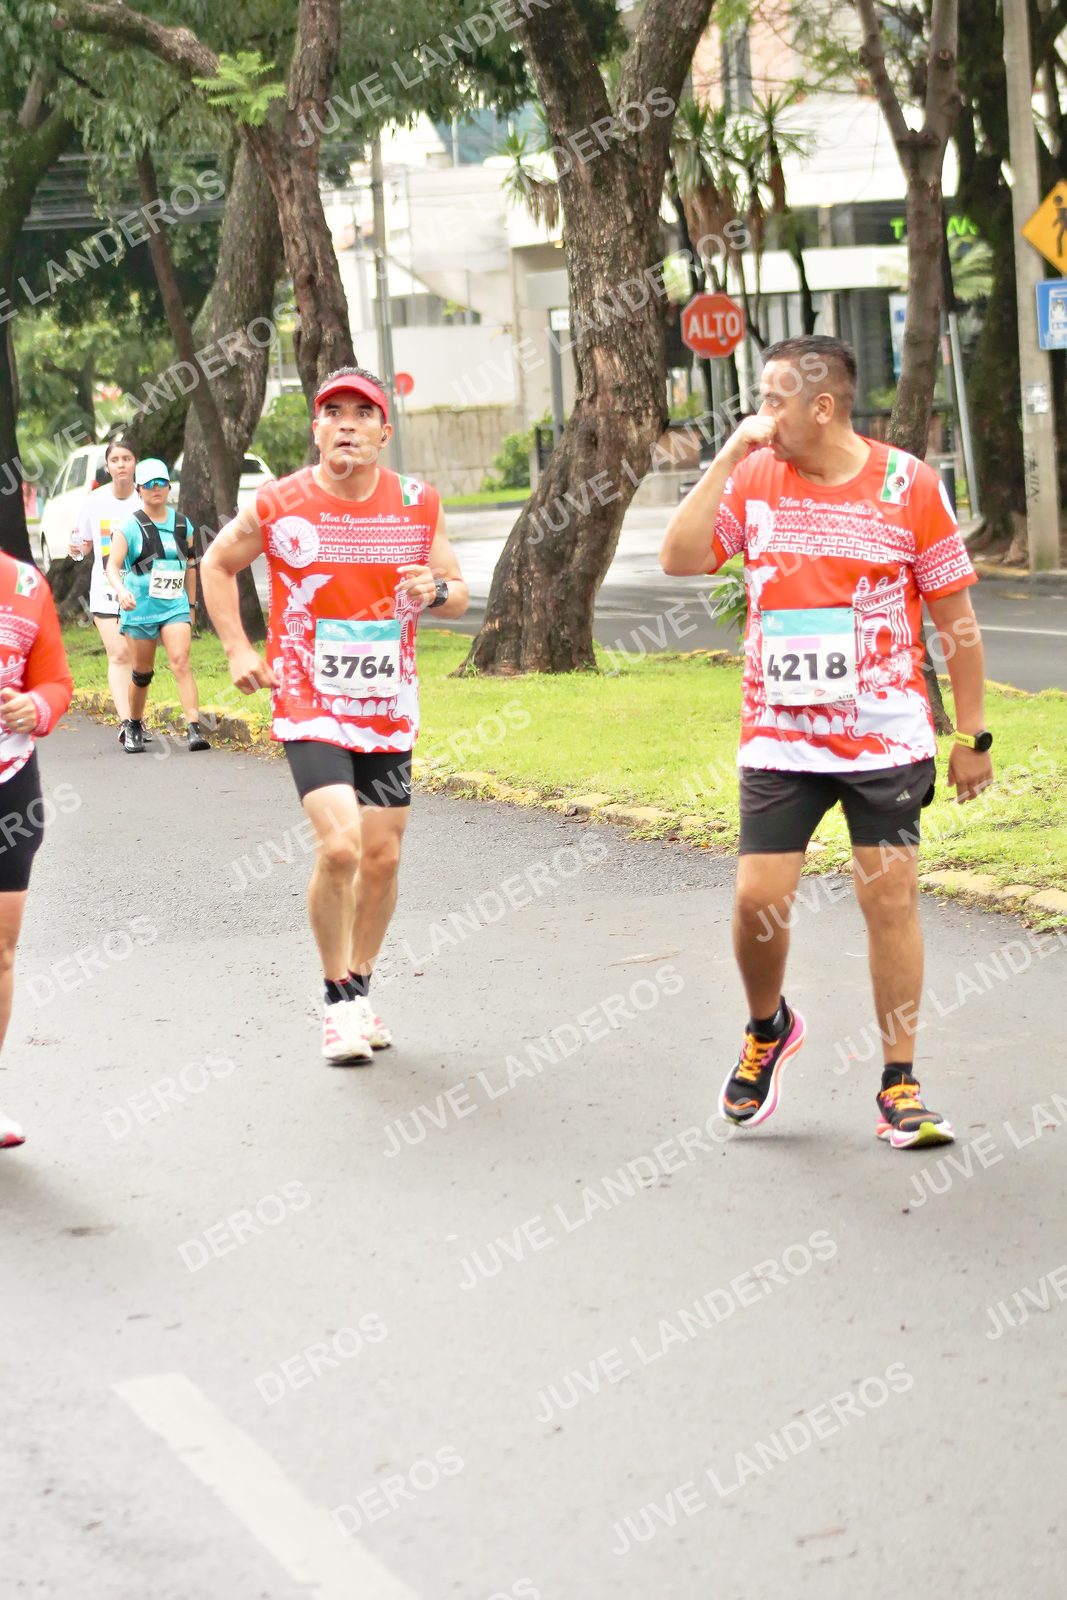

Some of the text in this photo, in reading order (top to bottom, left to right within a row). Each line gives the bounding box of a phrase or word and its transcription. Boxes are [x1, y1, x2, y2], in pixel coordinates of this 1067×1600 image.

[687, 312, 740, 339] ALTO
[780, 496, 801, 507] Viva
[319, 512, 340, 522] Viva
[153, 577, 183, 590] 2758
[320, 655, 395, 679] 3764
[767, 652, 847, 681] 4218
